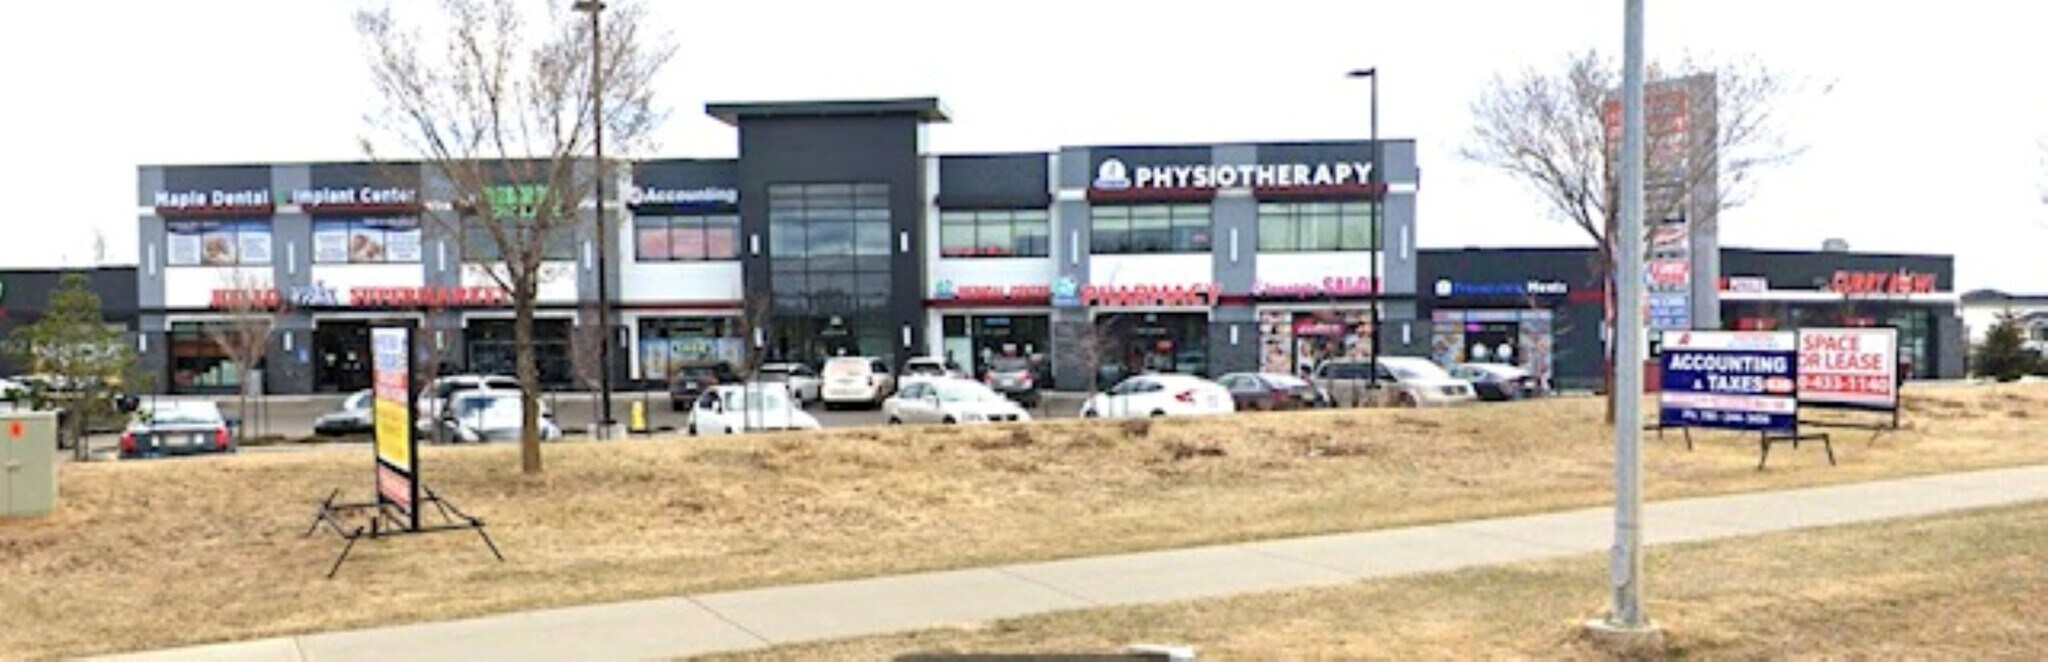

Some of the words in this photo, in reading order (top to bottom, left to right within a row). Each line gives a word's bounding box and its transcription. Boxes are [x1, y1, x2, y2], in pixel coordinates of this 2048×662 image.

[1136, 162, 1373, 188] PHYSIOTHERAPY
[155, 190, 204, 208] Maple
[212, 190, 269, 205] Dental
[292, 188, 356, 206] Implant
[359, 187, 416, 203] Center
[644, 187, 738, 204] Accounting
[1080, 283, 1223, 307] PHARMACY
[1803, 334, 1859, 351] SPACE
[1668, 353, 1788, 374] ACCOUNTING
[1797, 352, 1820, 369] OR
[1825, 353, 1885, 369] LEASE
[1706, 374, 1763, 392] TAXES
